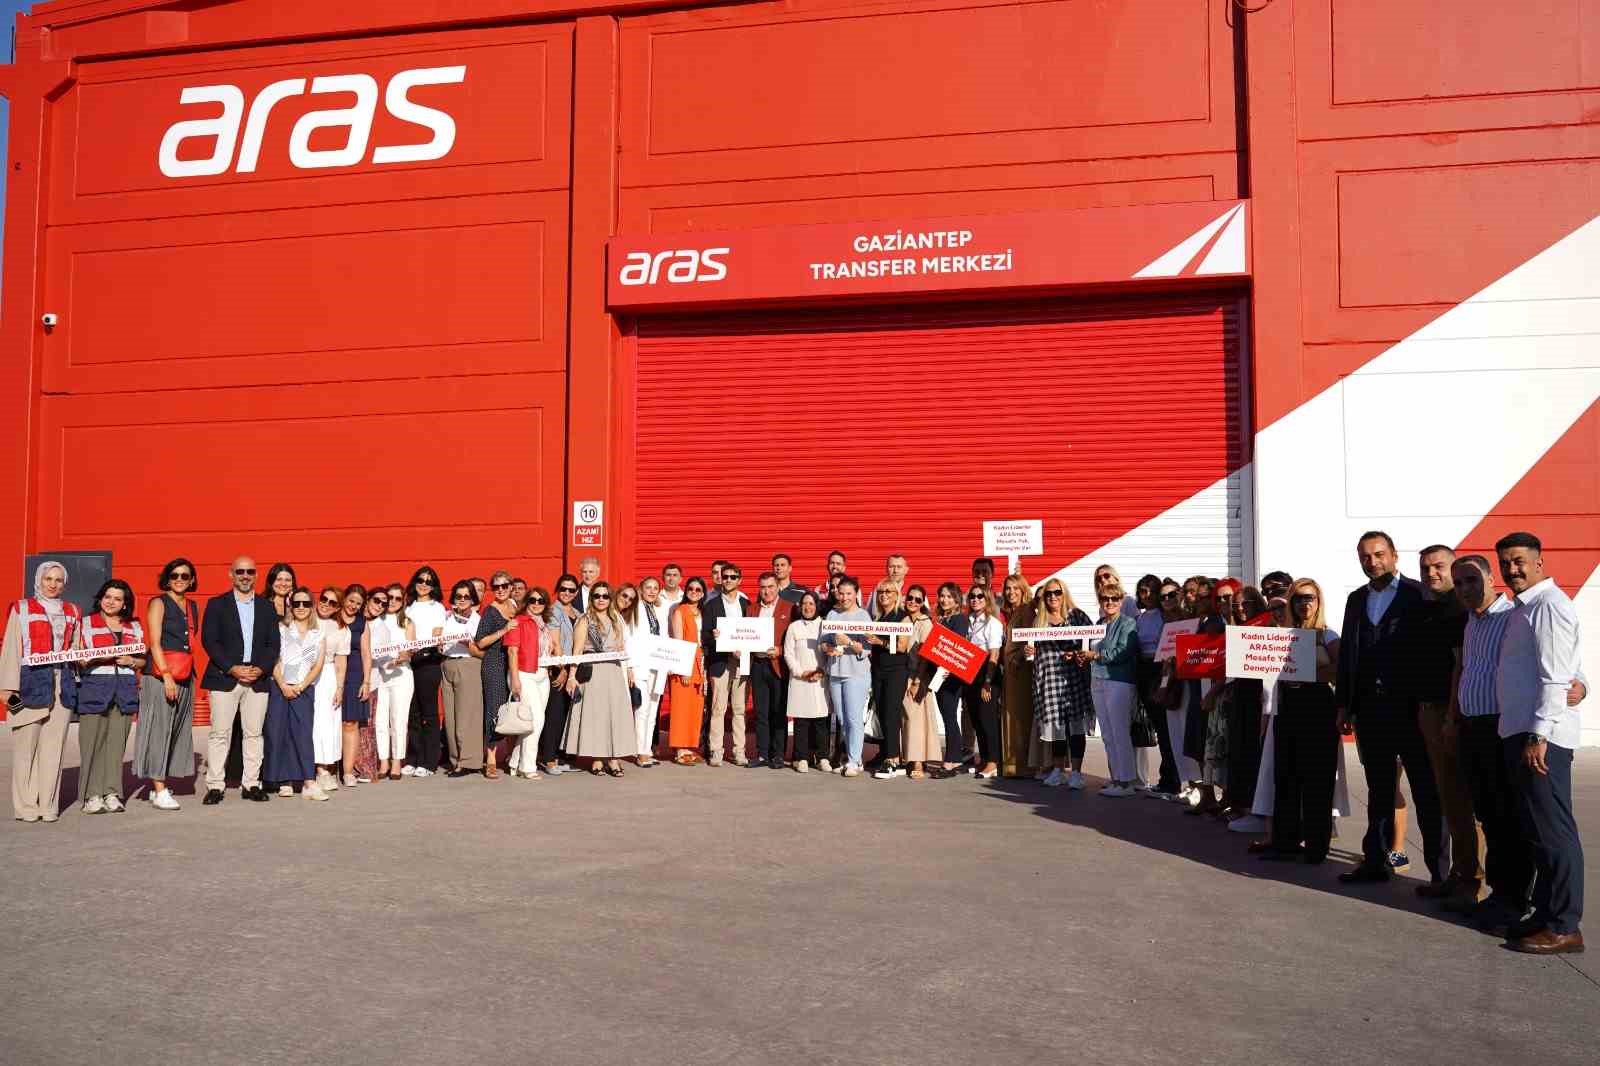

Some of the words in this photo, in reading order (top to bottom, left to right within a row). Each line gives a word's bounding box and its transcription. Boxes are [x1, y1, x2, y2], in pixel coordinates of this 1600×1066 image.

[158, 65, 467, 178] aras
[853, 229, 973, 253] GAZİANTEP
[619, 247, 730, 286] aras
[809, 259, 916, 280] TRANSFER
[922, 248, 1013, 274] MERKEZİ
[583, 508, 595, 518] 10
[1241, 632, 1265, 641] Kadın
[1267, 633, 1299, 642] Liderler
[1249, 643, 1292, 652] ARASında
[1245, 654, 1276, 662] Mesafe
[1243, 663, 1280, 674] Deneyim
